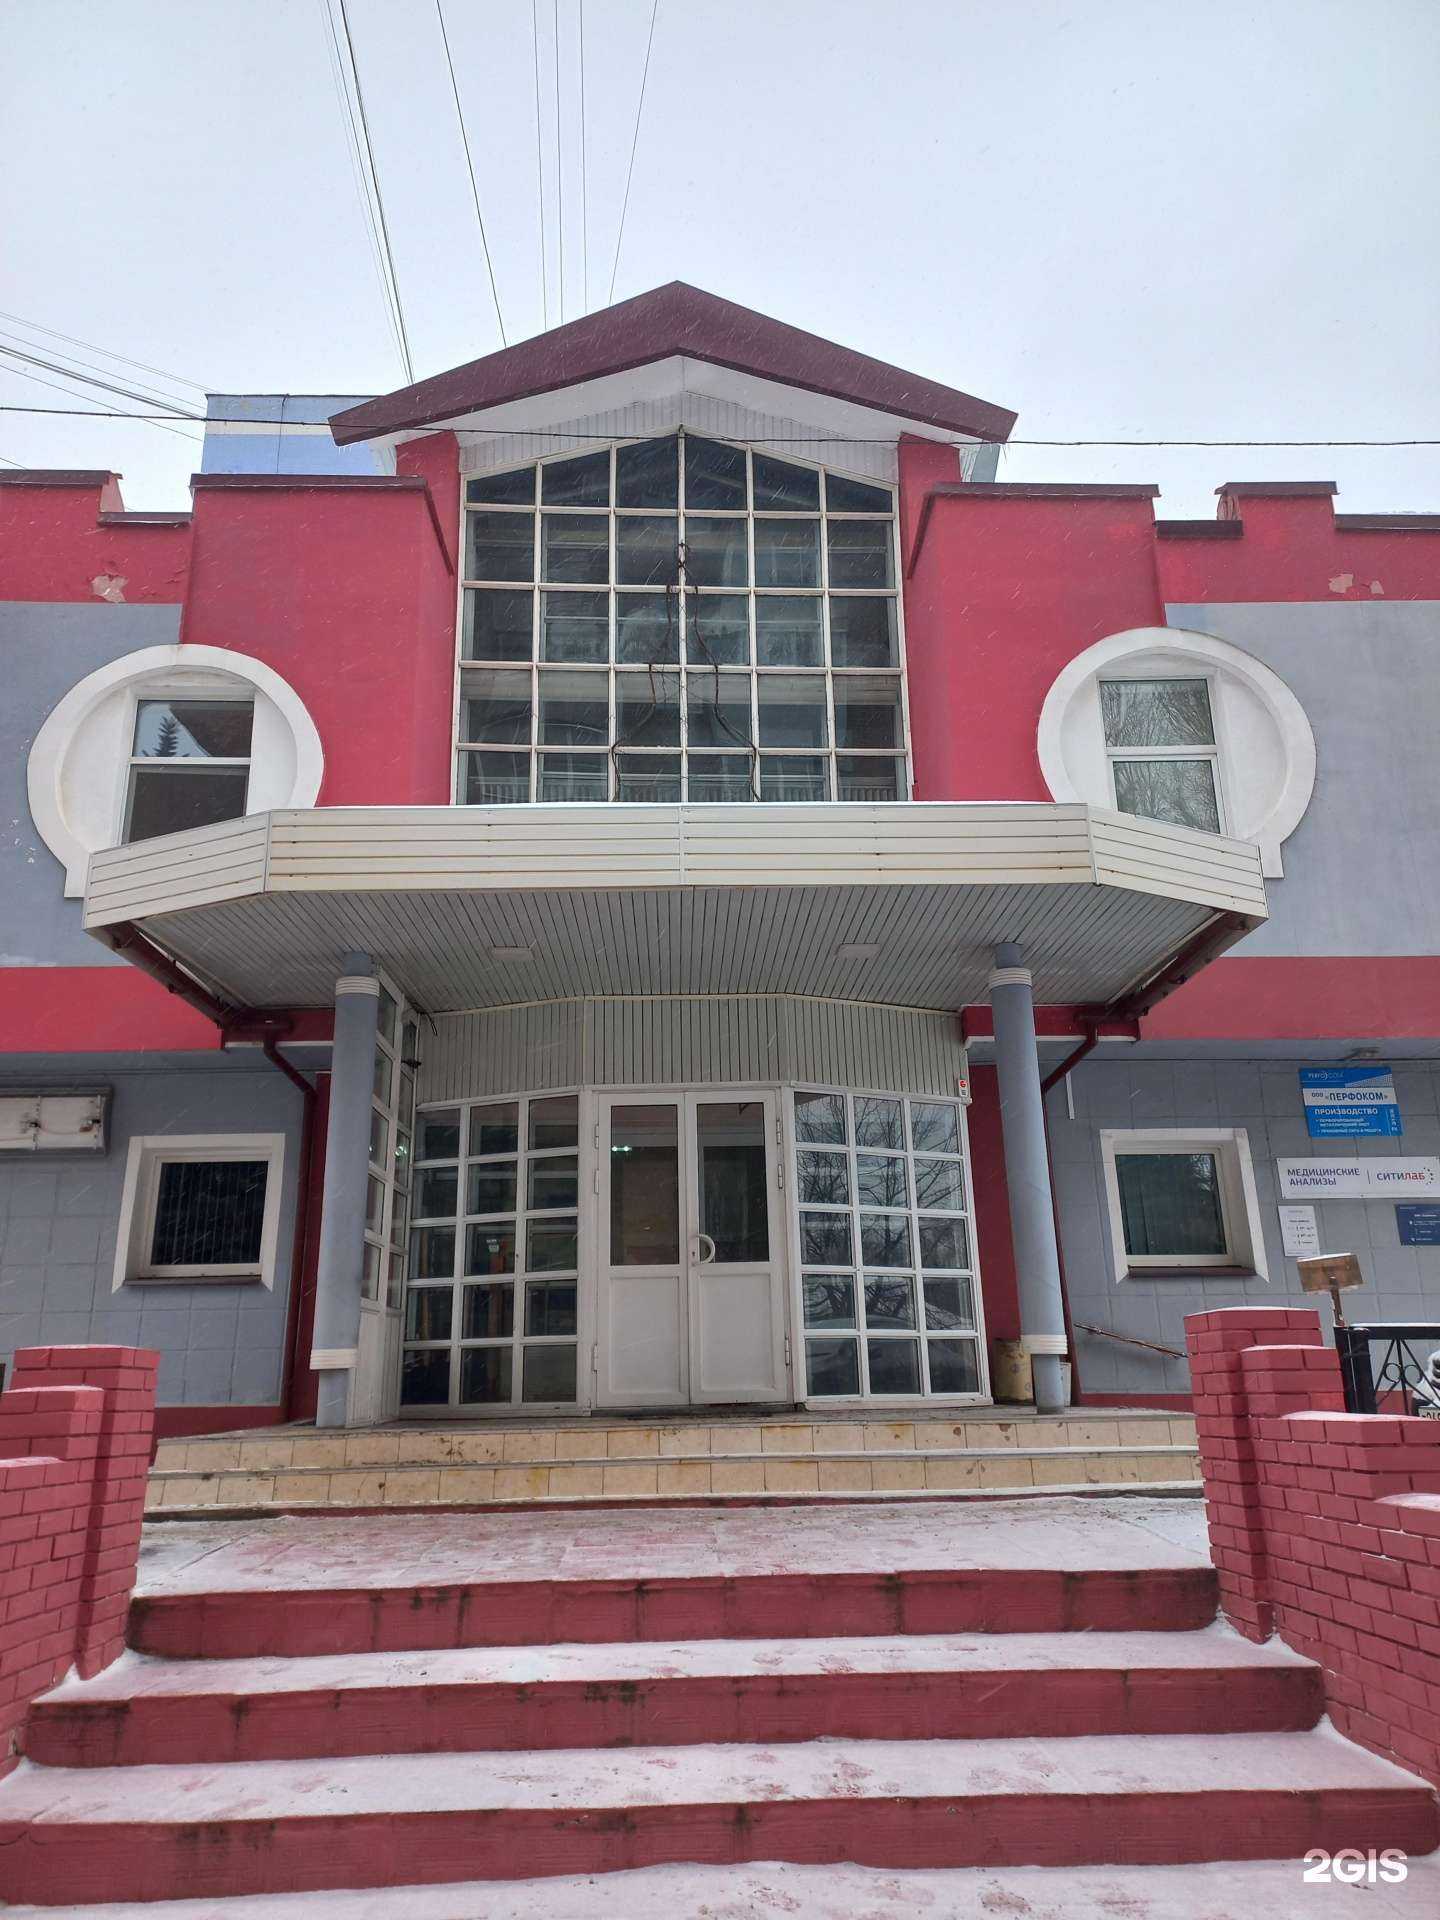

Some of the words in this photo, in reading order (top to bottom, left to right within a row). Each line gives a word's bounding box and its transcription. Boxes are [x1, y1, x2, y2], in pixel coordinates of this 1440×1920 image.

[1325, 1092, 1388, 1101] «ПЕРФОКОМ»
[1314, 1107, 1378, 1115] ПРОИЗВОДСТВО
[1287, 1167, 1361, 1177] МЕДИЦИНСКИЕ
[1289, 1177, 1337, 1186] АНАЛИЗЫ
